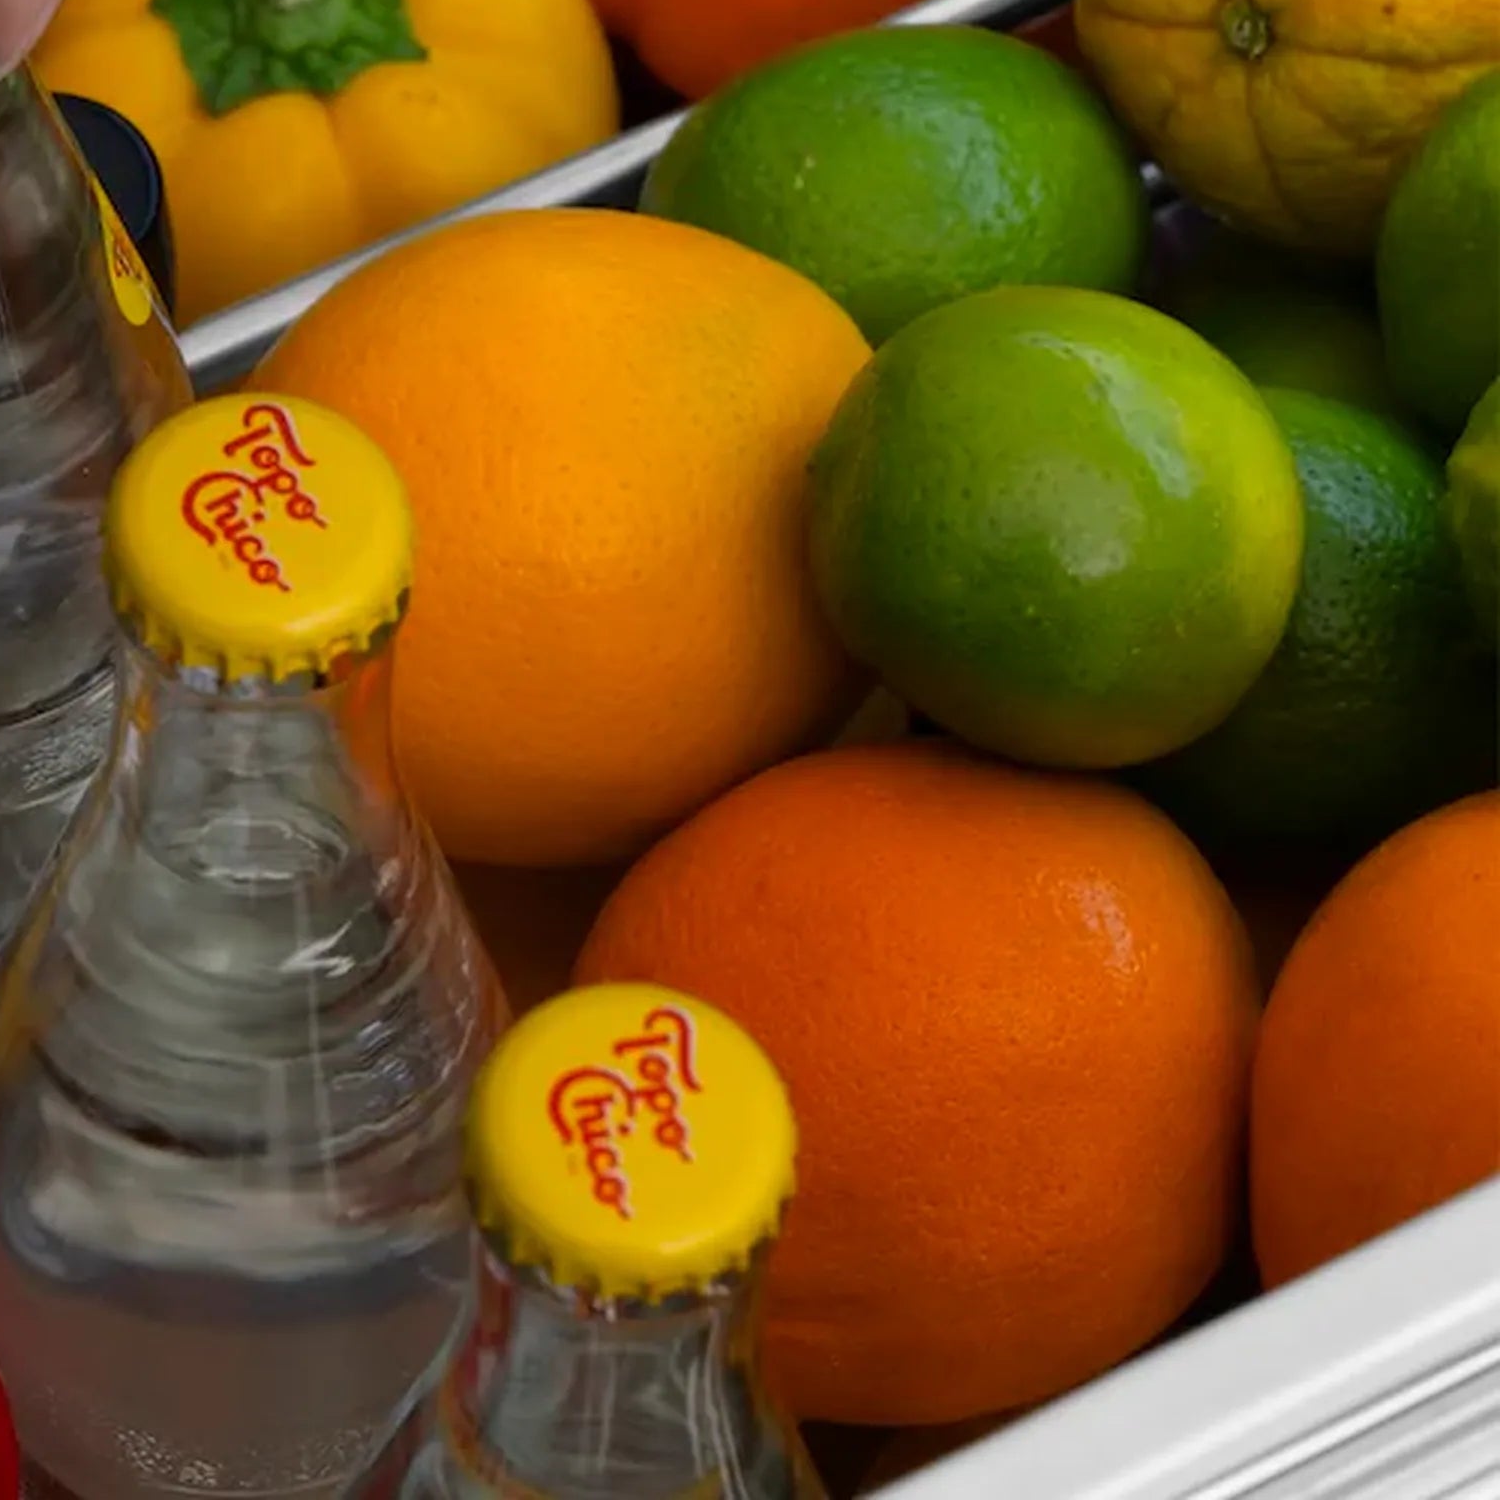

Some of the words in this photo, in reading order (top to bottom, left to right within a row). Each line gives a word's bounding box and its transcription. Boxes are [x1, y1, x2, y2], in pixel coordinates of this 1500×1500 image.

[182, 471, 293, 593] Chico
[223, 404, 328, 530] Topo
[548, 1067, 634, 1220] Chico
[612, 1008, 703, 1163] Topo
